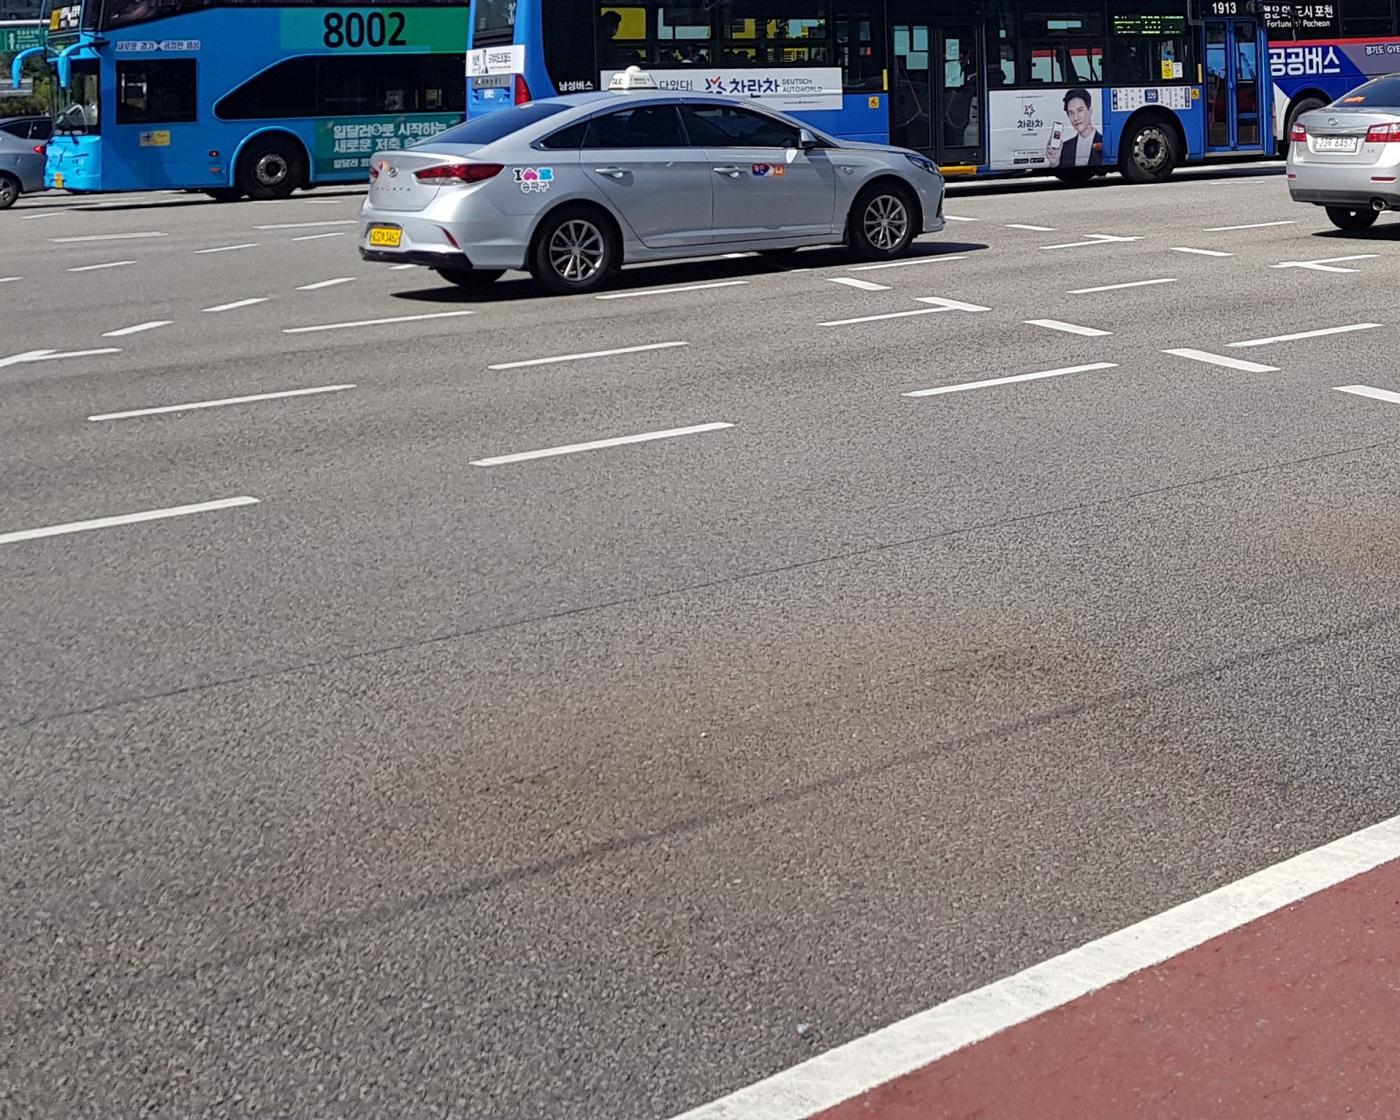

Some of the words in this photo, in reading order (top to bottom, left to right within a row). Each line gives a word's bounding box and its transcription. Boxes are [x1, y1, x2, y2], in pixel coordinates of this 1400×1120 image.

[1212, 2, 1237, 14] 1913
[1315, 4, 1334, 18] 포천
[323, 12, 406, 48] 8002
[1366, 45, 1385, 55] 경기도
[1268, 46, 1341, 77] 공공버스
[558, 81, 594, 91] 남성버스
[729, 77, 780, 98] 차란차
[1017, 119, 1044, 131] 차란차
[333, 137, 372, 153] 새로운
[375, 136, 400, 150] 저축
